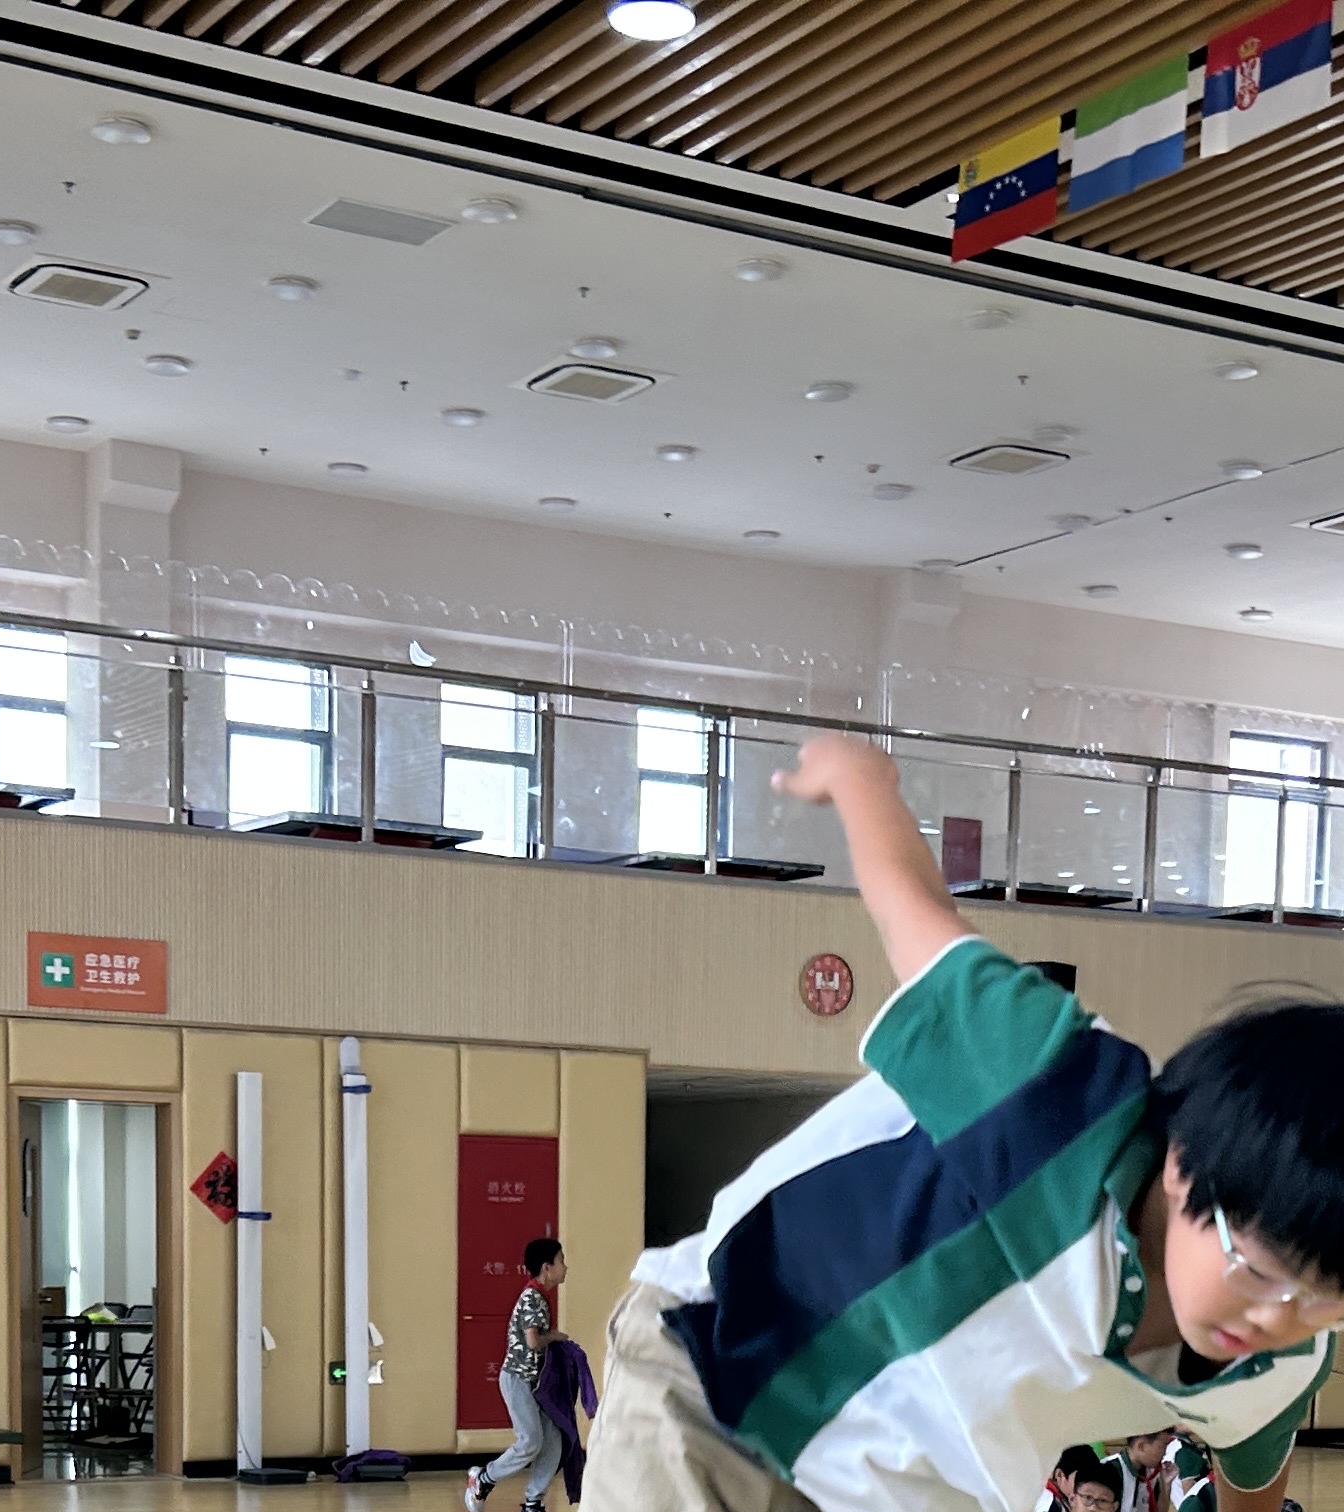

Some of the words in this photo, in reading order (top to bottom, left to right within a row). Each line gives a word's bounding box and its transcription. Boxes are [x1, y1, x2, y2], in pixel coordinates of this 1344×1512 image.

[85, 953, 140, 970] 应急医疗
[85, 969, 140, 986] 卫生救护
